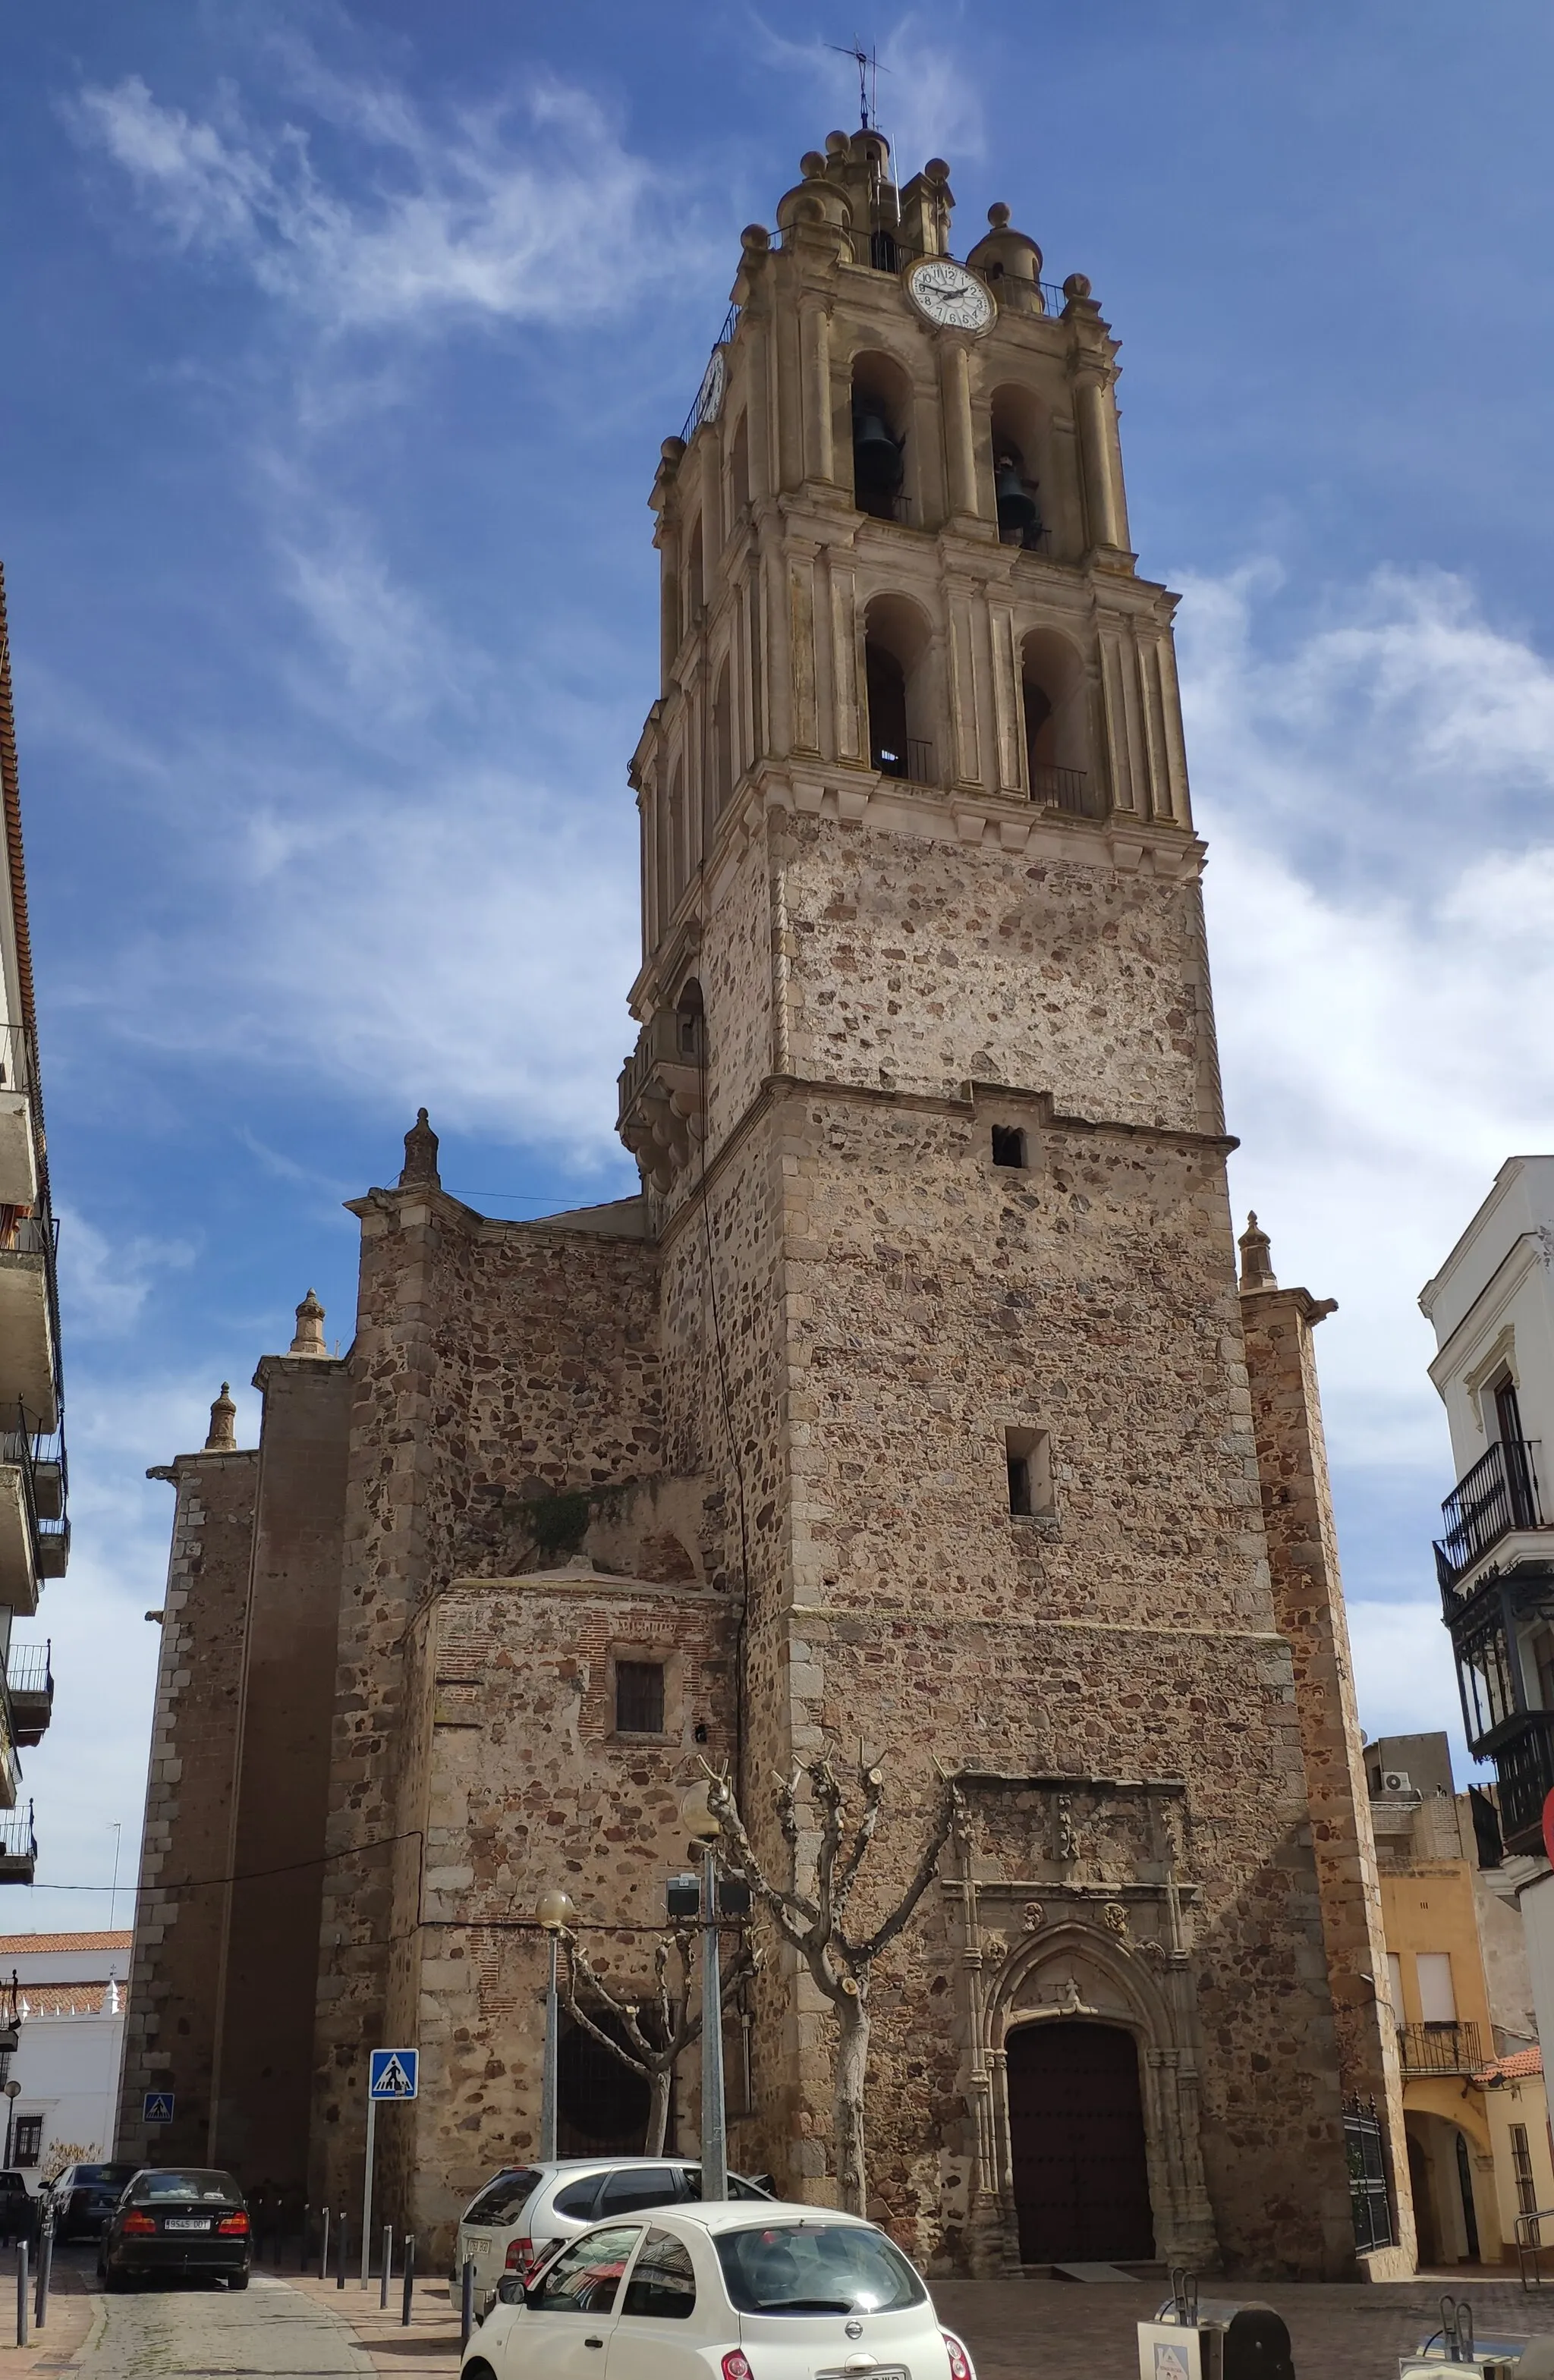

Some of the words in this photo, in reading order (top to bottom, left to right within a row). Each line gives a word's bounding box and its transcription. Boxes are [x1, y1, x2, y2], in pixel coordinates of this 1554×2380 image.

[922, 273, 932, 283] 10
[933, 269, 940, 278] 11
[945, 270, 955, 280] 12
[970, 287, 977, 296] 2
[924, 296, 932, 306] 8
[977, 299, 983, 309] 3
[936, 307, 942, 316] 7
[972, 310, 979, 319] 4
[949, 313, 956, 322] 6
[962, 314, 969, 324] 5
